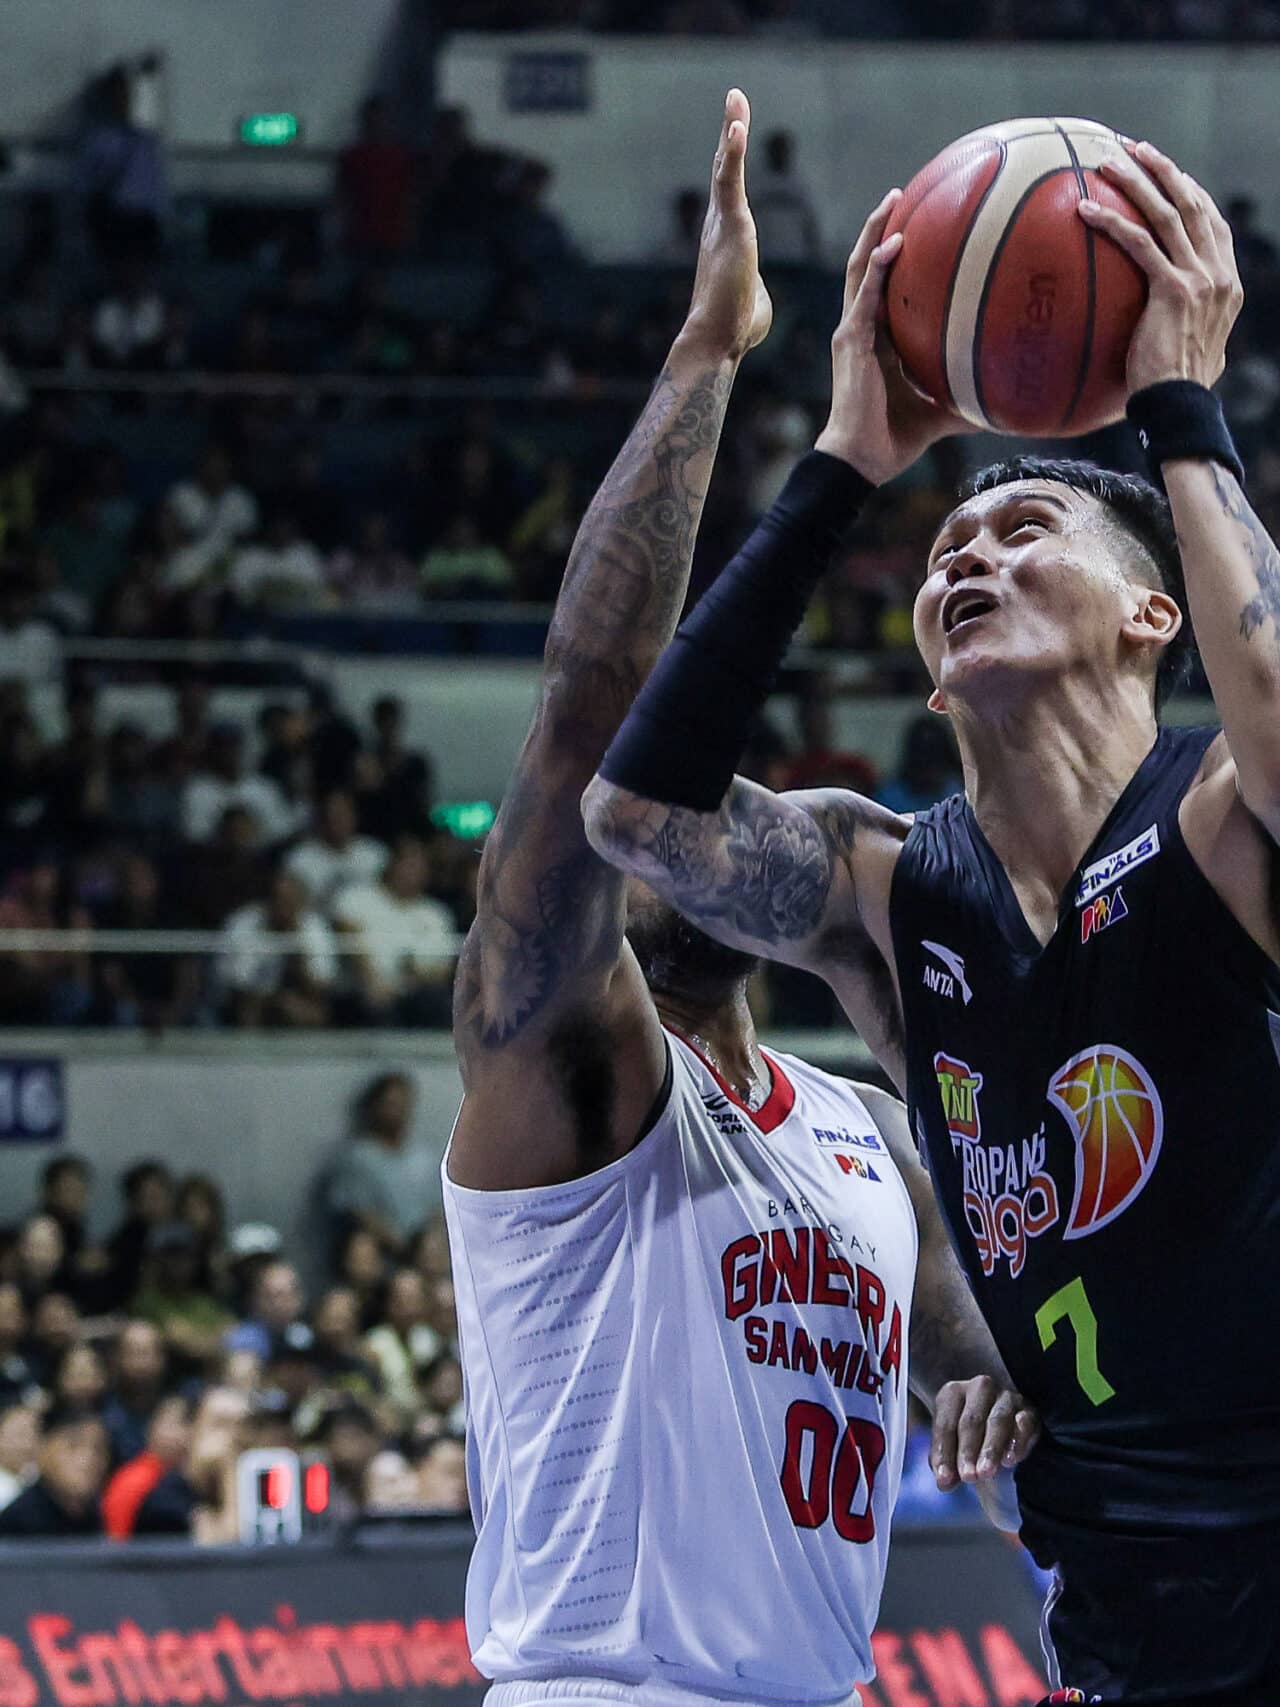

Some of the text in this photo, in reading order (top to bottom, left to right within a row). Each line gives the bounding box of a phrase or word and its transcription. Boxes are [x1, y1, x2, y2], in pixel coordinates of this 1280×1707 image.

[1077, 836, 1153, 899] FINALS
[922, 965, 953, 999] ANTA
[936, 1071, 980, 1123] TNT
[812, 1127, 881, 1151] FINALS
[744, 1316, 819, 1376] SAN
[1035, 1276, 1117, 1406] 7
[780, 1399, 886, 1544] 00
[28, 1604, 484, 1706] Entertainme
